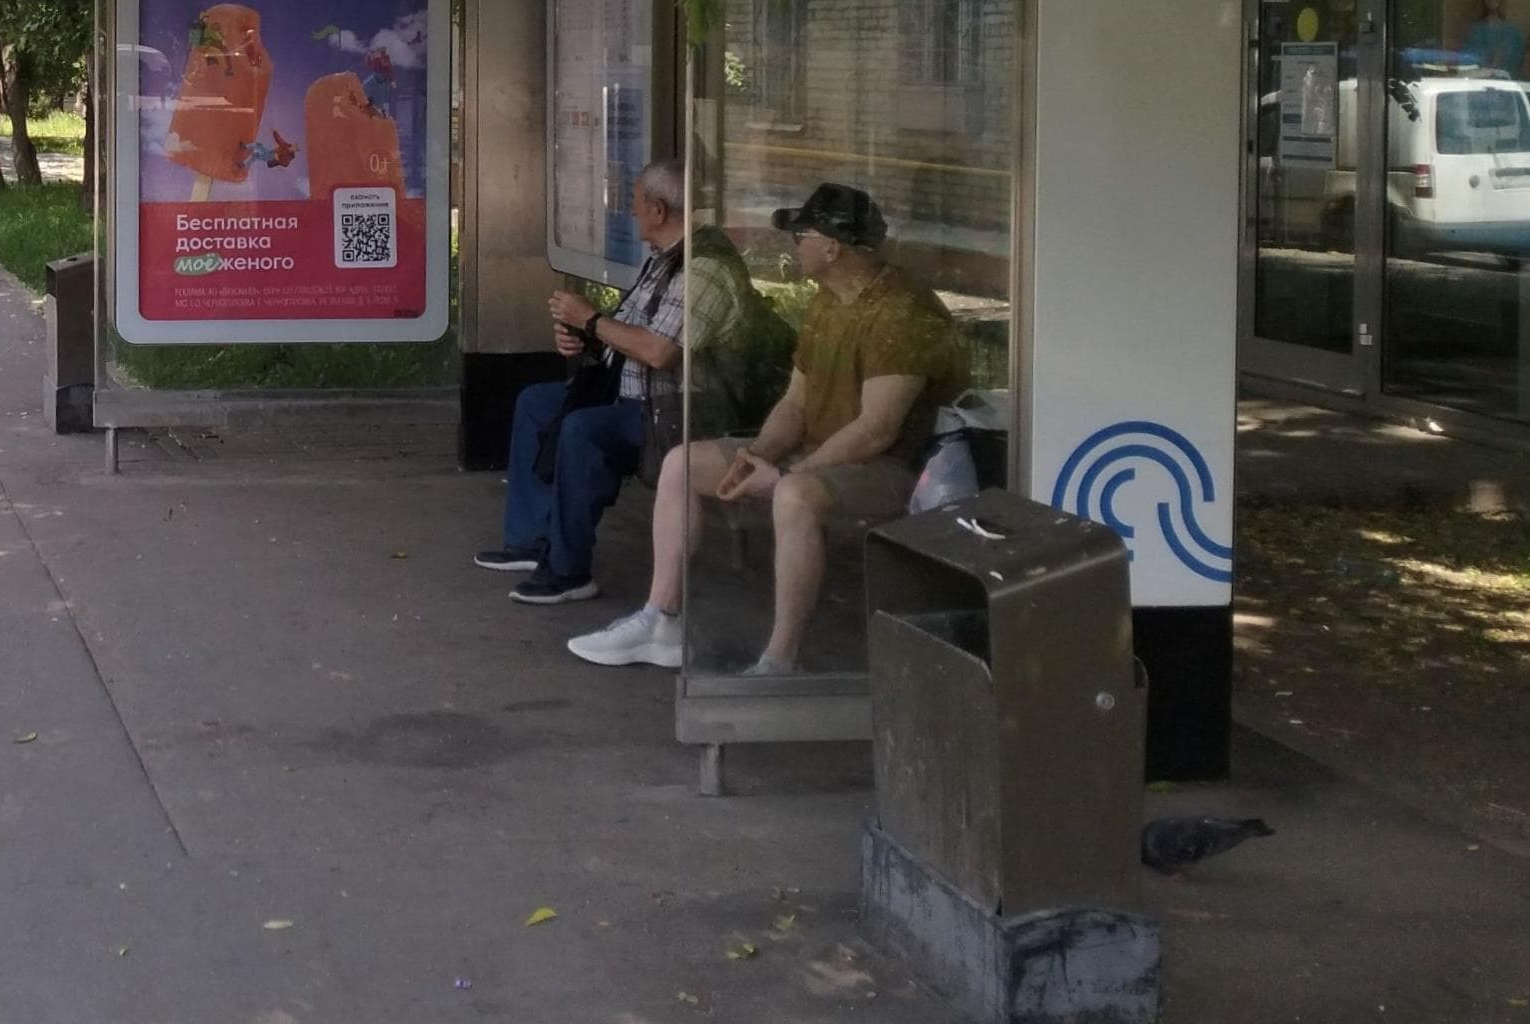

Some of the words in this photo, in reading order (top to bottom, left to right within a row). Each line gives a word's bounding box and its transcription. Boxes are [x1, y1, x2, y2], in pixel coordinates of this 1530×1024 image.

[370, 153, 390, 173] 0+
[176, 214, 298, 231] Бесплатная
[175, 236, 272, 253] доставка
